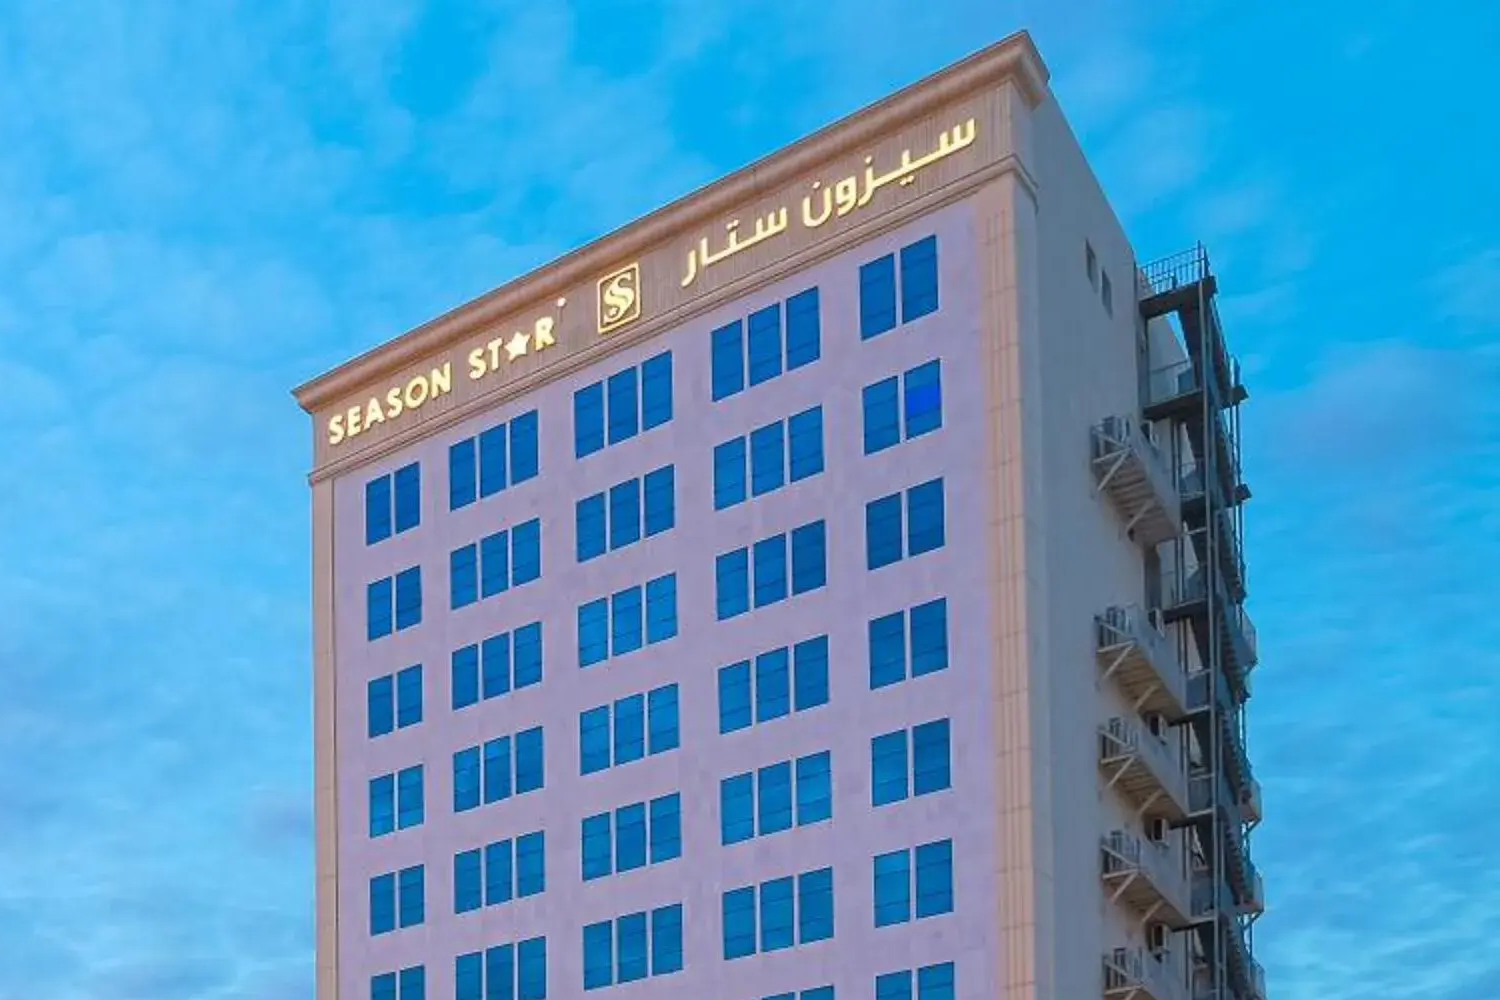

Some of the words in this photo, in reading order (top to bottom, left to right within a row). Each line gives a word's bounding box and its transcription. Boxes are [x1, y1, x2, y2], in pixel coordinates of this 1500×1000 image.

[802, 117, 977, 228] سيزون
[681, 205, 788, 287] ستار
[329, 362, 452, 445] SEASON
